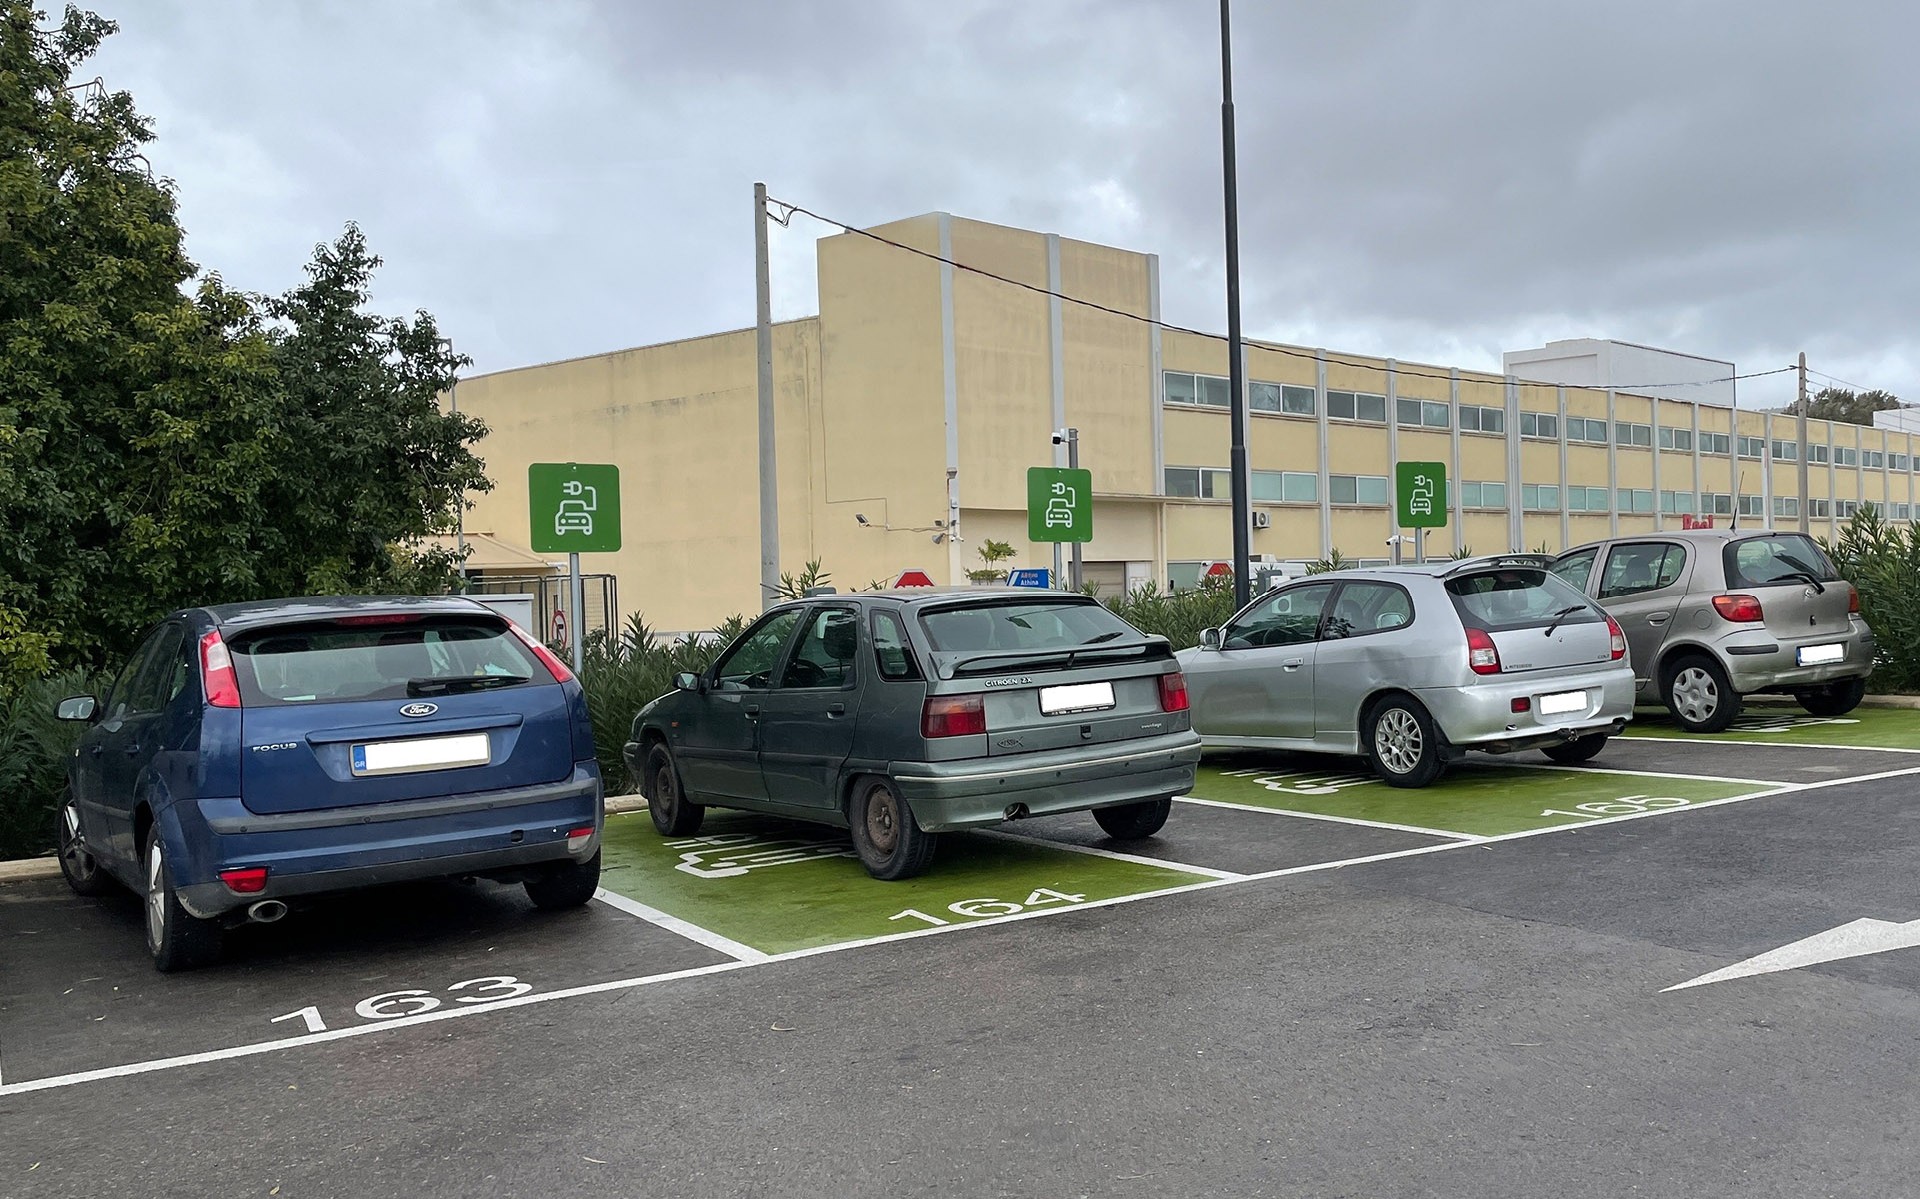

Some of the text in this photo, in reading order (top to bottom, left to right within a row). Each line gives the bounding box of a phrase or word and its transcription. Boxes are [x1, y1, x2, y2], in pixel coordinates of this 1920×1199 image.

[252, 742, 297, 753] FOCUS
[354, 761, 366, 769] GR
[1540, 794, 1691, 819] 165
[888, 887, 1087, 926] 164
[271, 976, 534, 1033] 163
